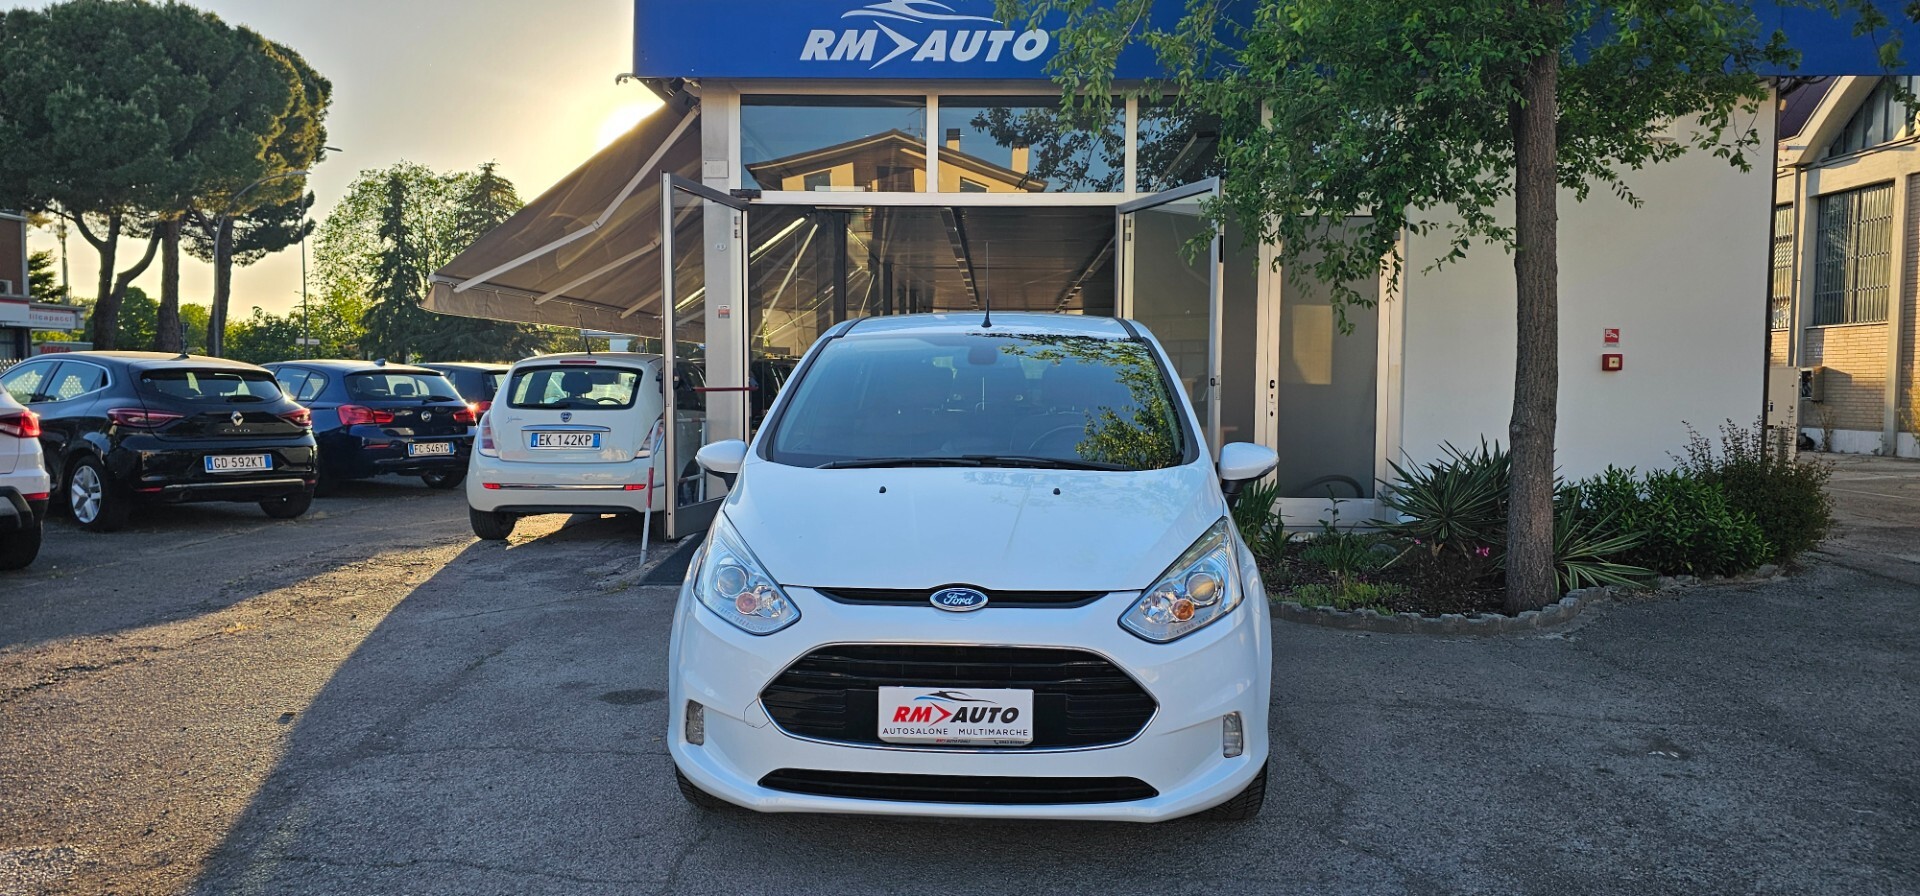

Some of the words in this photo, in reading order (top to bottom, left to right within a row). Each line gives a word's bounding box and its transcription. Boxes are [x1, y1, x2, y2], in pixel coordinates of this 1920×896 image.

[910, 28, 1050, 62] AUTO
[538, 433, 552, 447] EK
[557, 433, 592, 447] 142KP
[214, 457, 228, 469] GD
[231, 456, 264, 468] 592KT
[943, 592, 974, 605] Ford
[892, 706, 933, 723] RM
[950, 706, 1020, 724] AUTO
[882, 727, 949, 736] AUTOSALONE
[958, 728, 1029, 737] MULTIMARCHE
